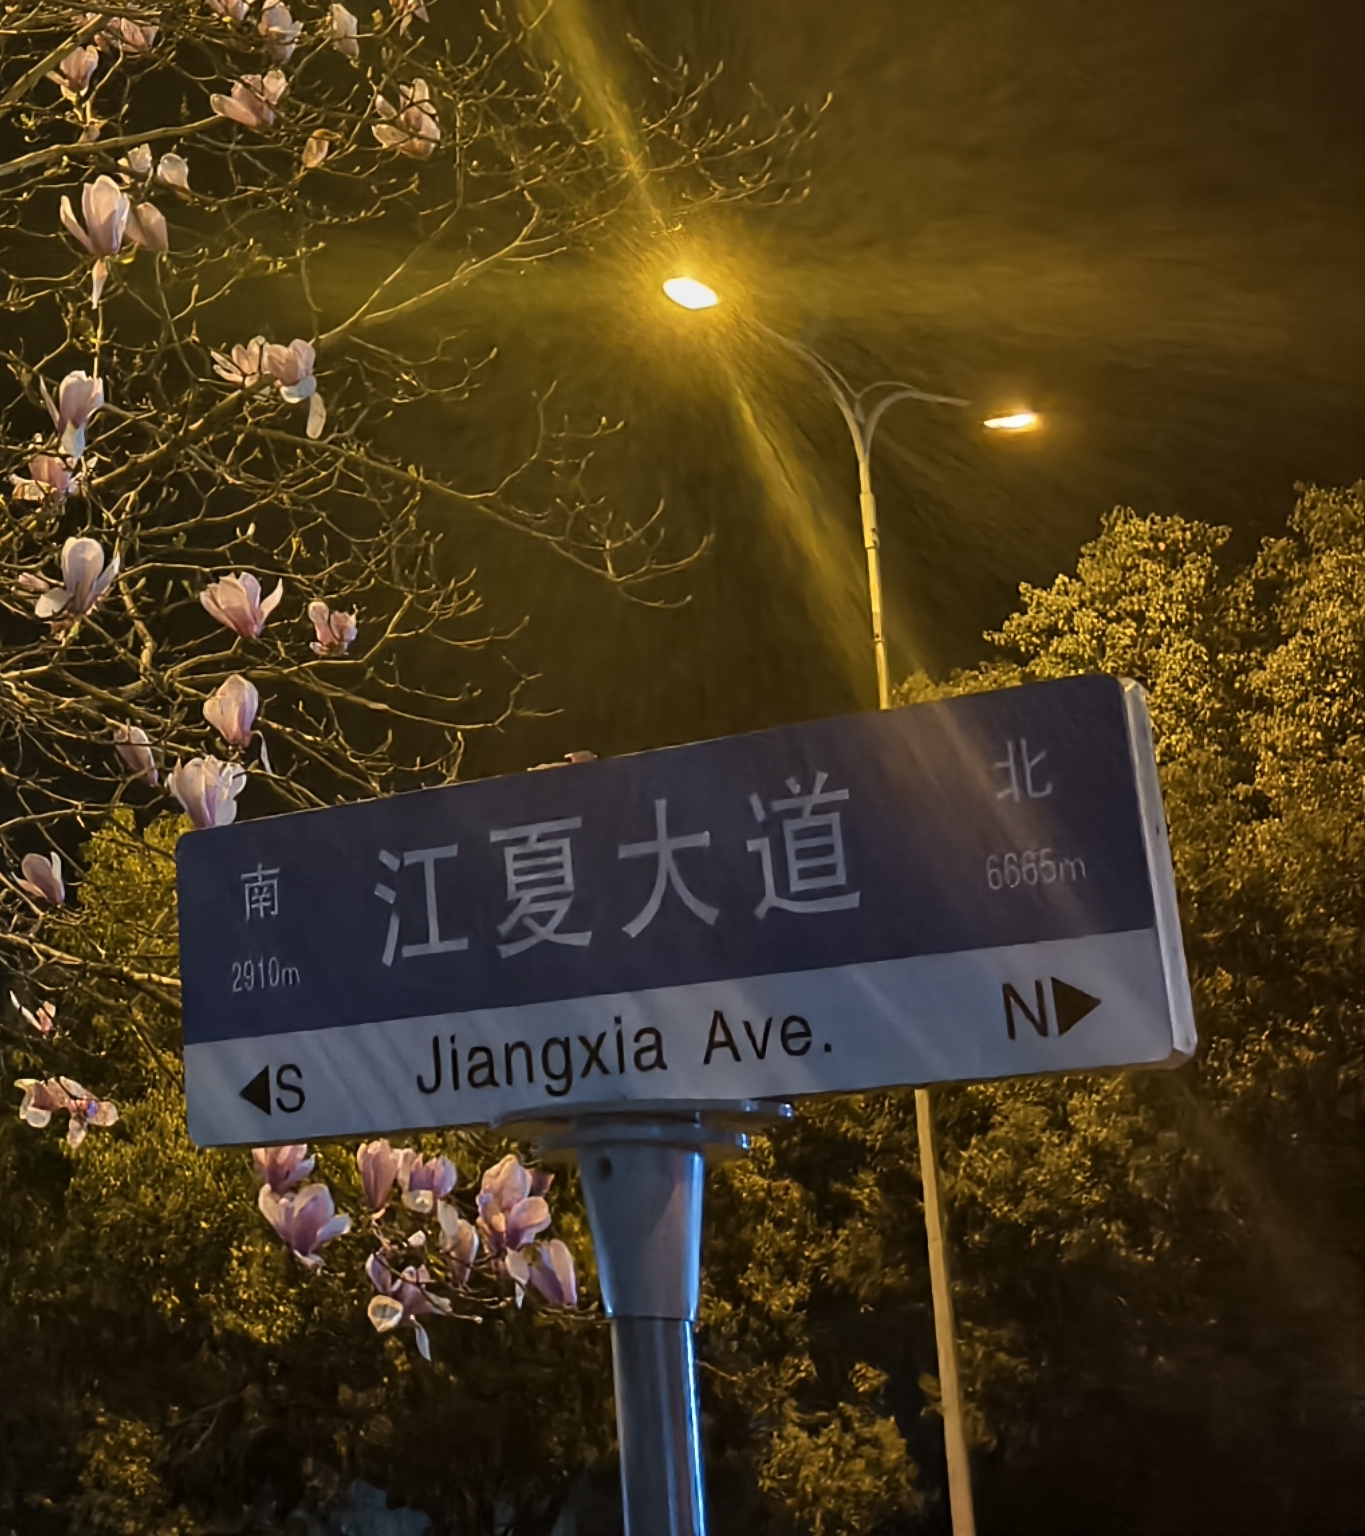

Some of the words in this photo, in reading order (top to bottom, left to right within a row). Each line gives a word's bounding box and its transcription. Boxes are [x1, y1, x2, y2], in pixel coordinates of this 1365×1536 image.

[995, 739, 1052, 802] 北
[241, 864, 280, 920] 南
[374, 772, 861, 966] 江夏大道
[232, 957, 300, 992] 2910m
[1002, 979, 1048, 1041] N
[417, 1016, 667, 1097] Jiangxia
[703, 1010, 832, 1066] Ave.
[276, 1063, 305, 1113] S
